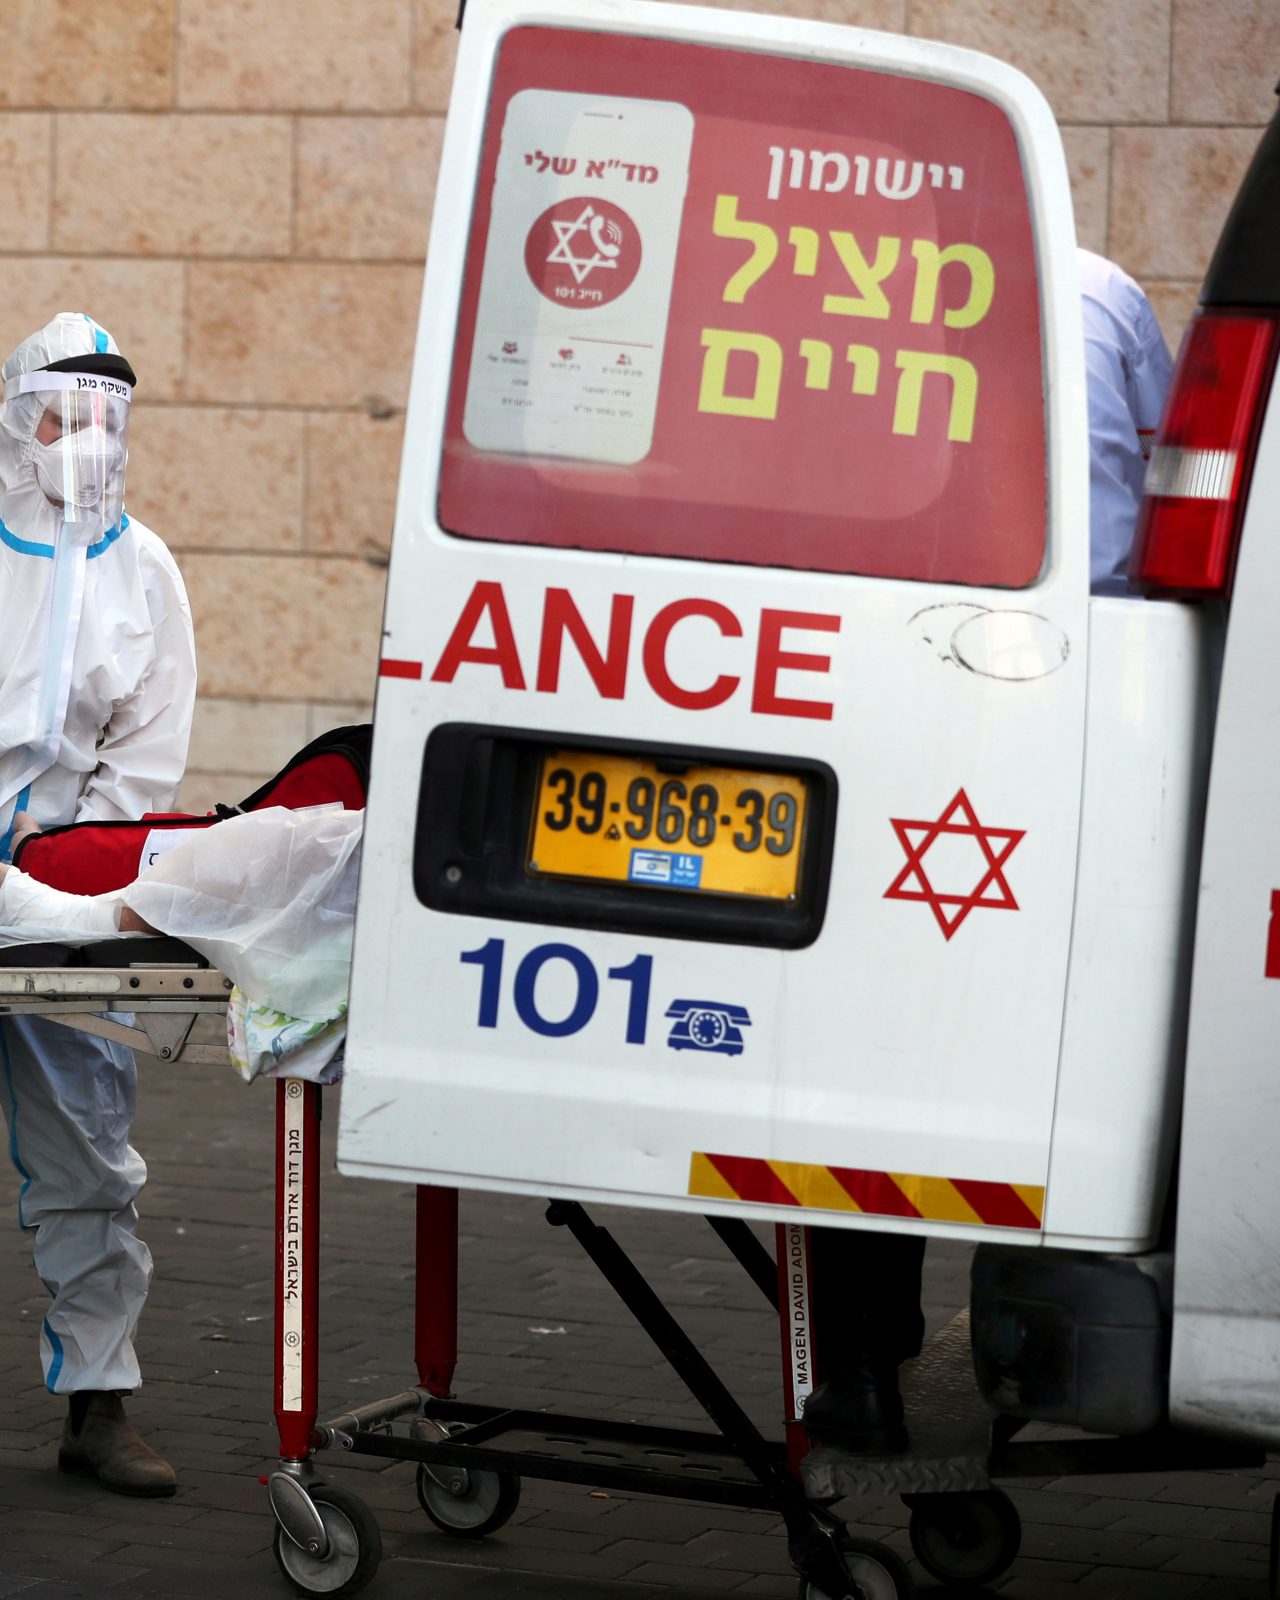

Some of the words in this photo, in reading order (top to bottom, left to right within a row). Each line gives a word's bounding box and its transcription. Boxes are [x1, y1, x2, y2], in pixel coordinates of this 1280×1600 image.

[523, 150, 578, 176] שלי
[767, 146, 965, 201] יישומון
[712, 193, 996, 329] מציל
[553, 286, 576, 300] 101
[76, 377, 98, 389] מגן
[100, 380, 127, 396] משקף
[697, 327, 979, 443] חיים
[460, 937, 653, 1045] 101
[288, 1129, 302, 1156] מגן
[288, 1161, 300, 1188] דוד
[288, 1193, 299, 1234] אדום
[285, 1239, 299, 1300] בישראל
[792, 1273, 805, 1321] DAVID
[795, 1327, 808, 1385] MAGEN
